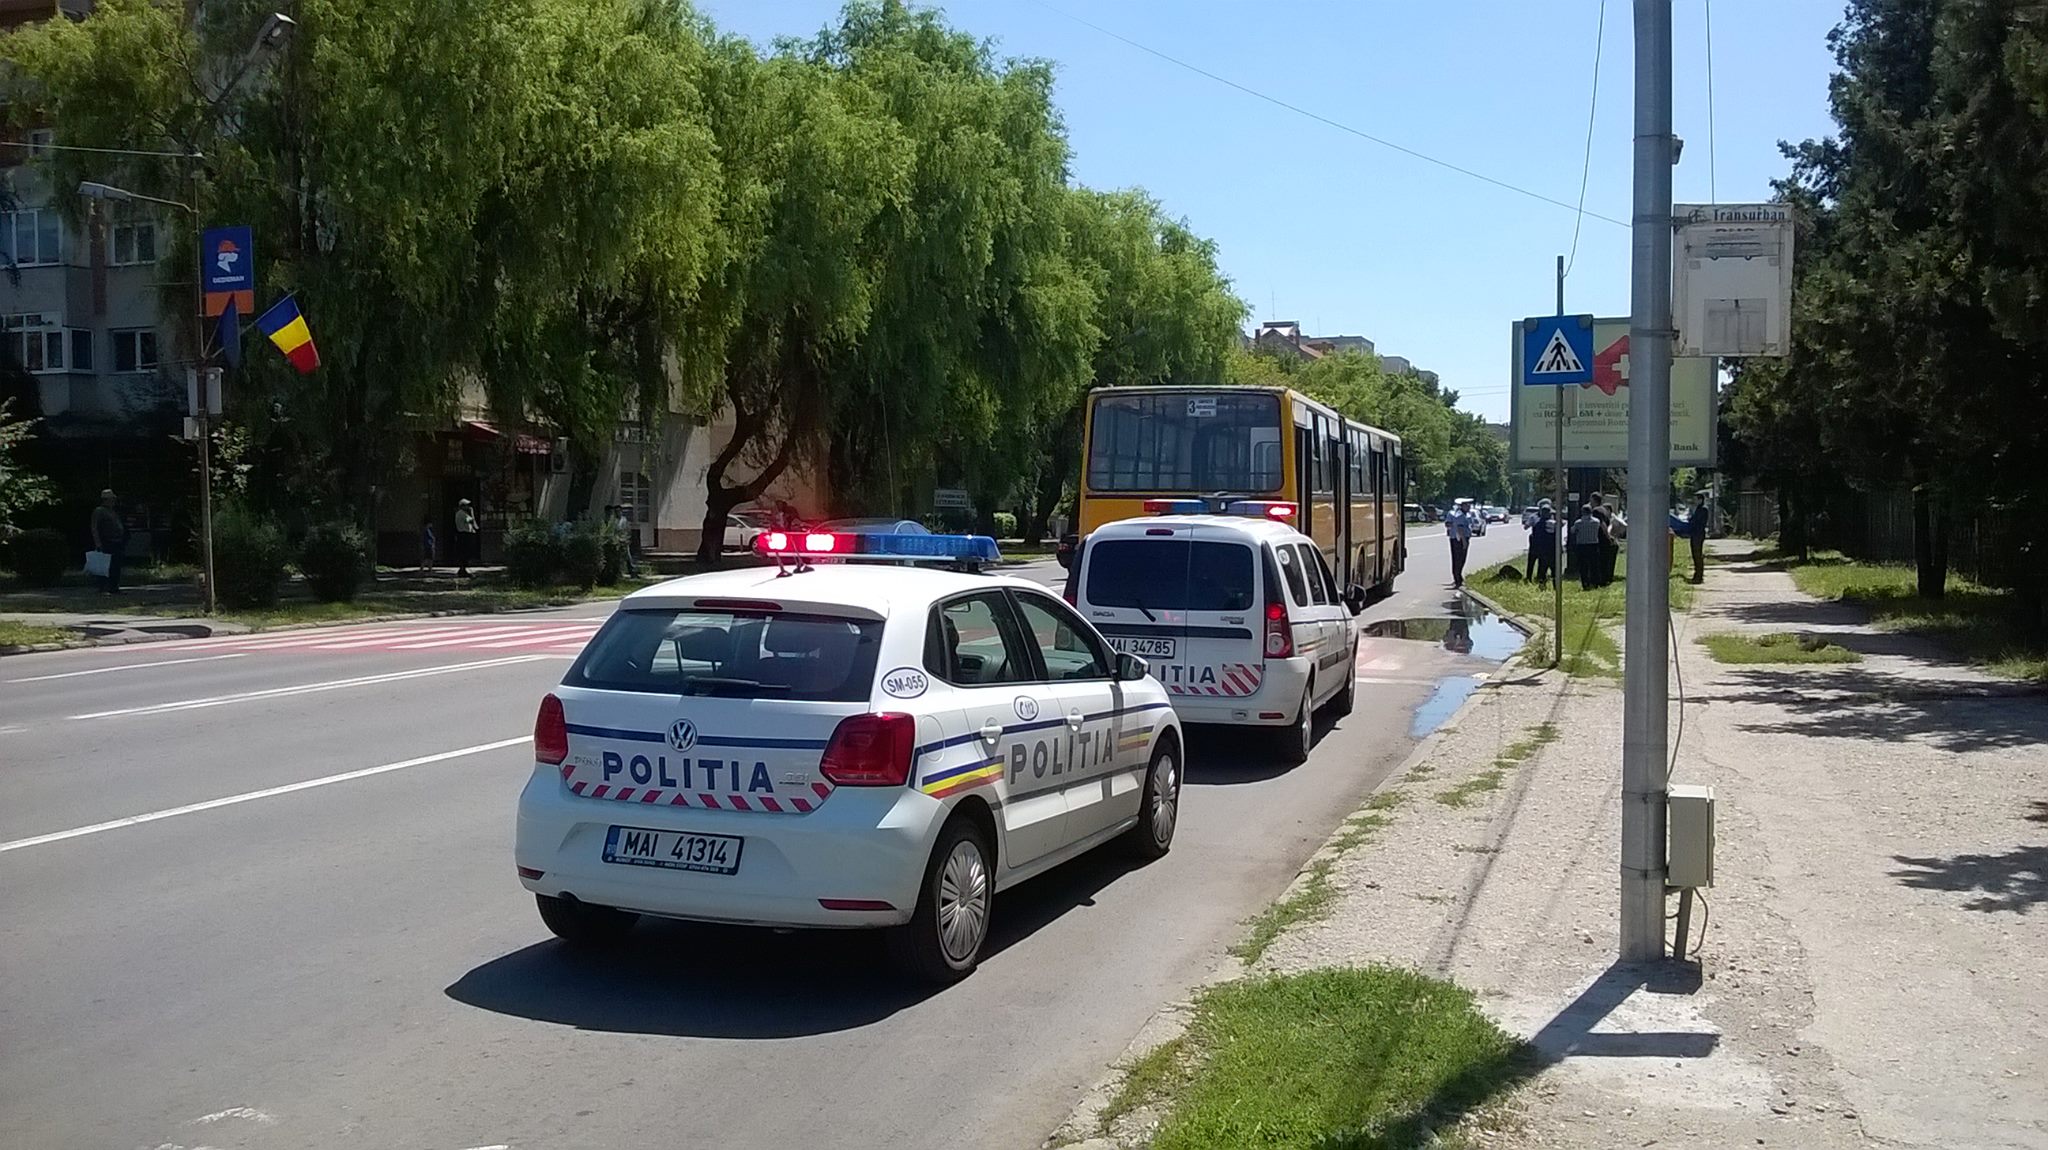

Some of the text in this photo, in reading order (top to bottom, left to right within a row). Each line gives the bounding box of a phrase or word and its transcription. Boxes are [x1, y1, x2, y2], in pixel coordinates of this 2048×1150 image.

[1713, 208, 1785, 221] Transurban
[1188, 400, 1196, 414] 3
[1674, 443, 1699, 451] Bank
[1131, 640, 1171, 655] 34785
[887, 674, 925, 694] SM-055
[1148, 664, 1217, 684] ITIA
[1009, 727, 1114, 785] POLITIA
[602, 751, 774, 793] POLITIA
[623, 831, 728, 864] MAI 41314
